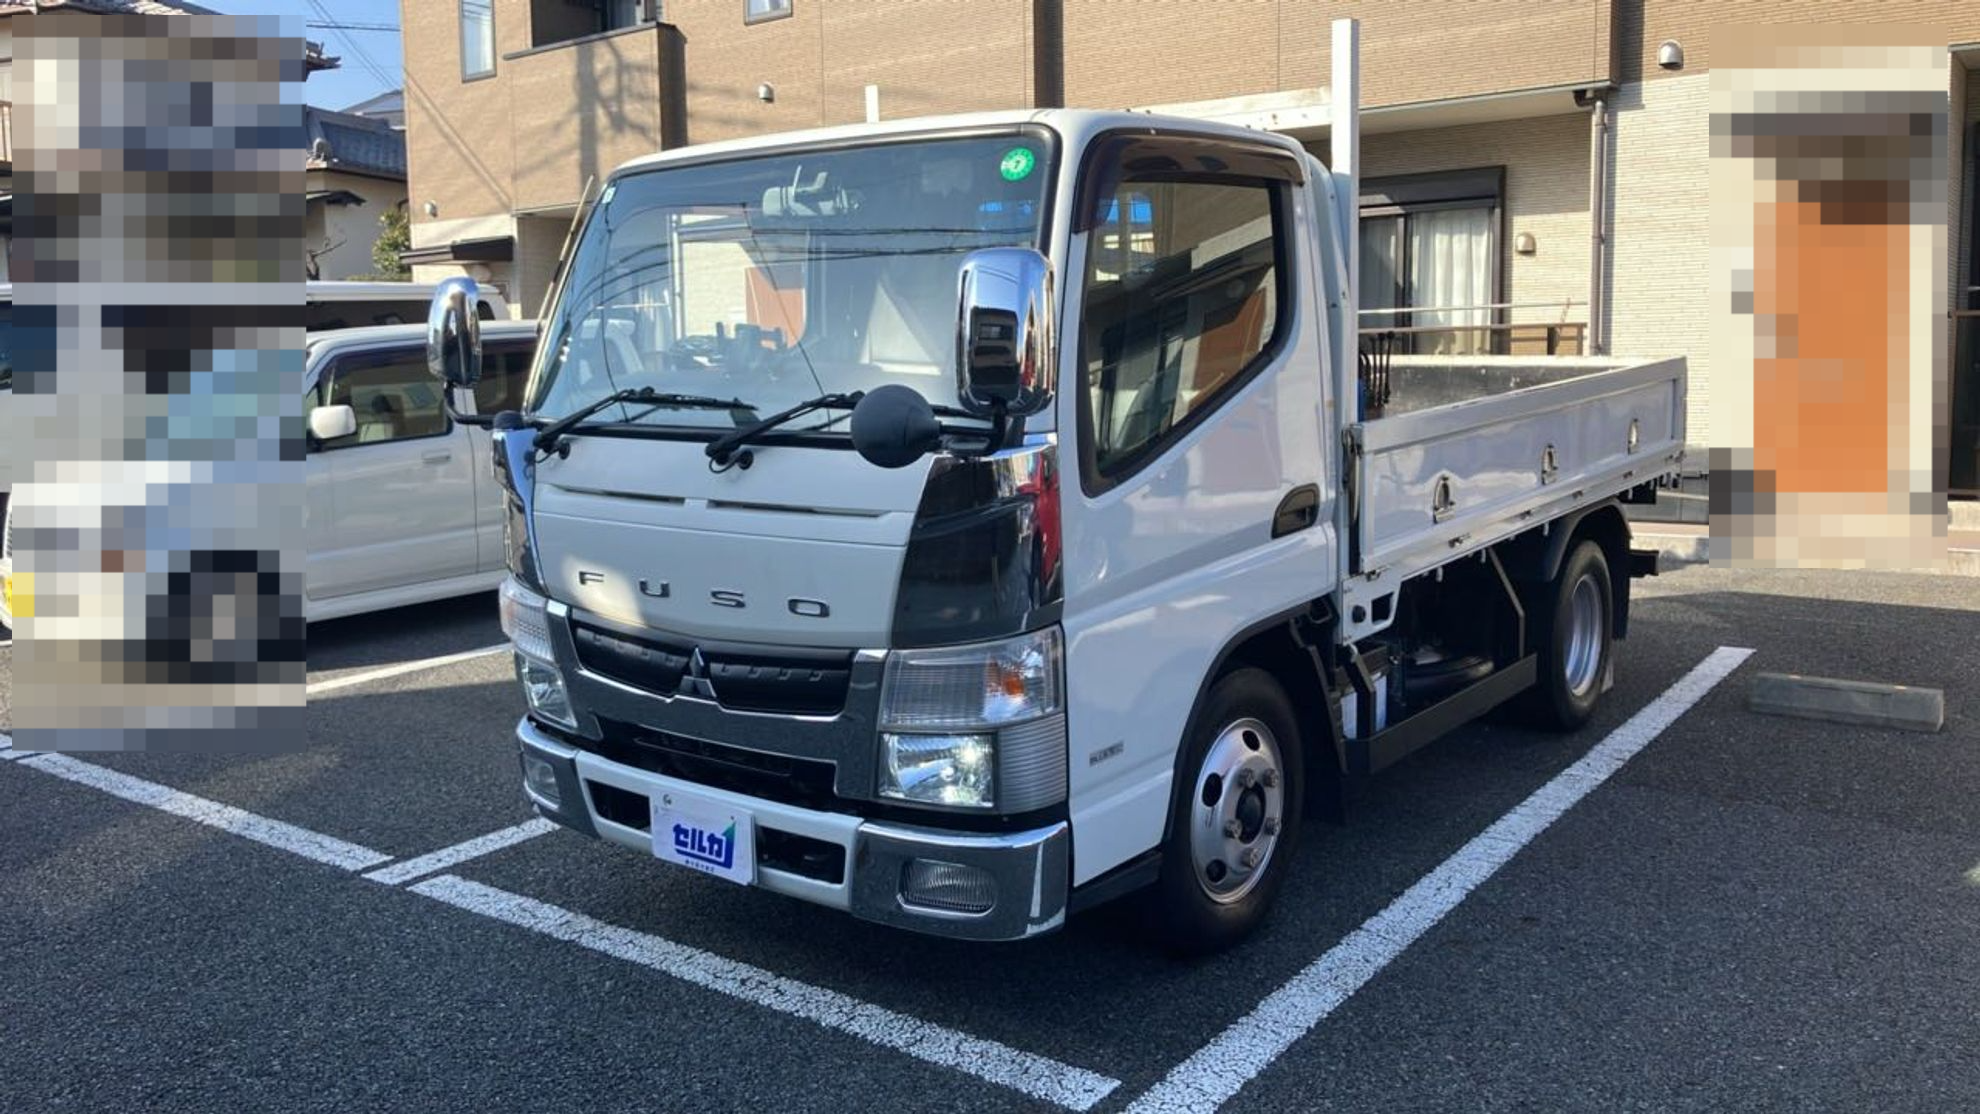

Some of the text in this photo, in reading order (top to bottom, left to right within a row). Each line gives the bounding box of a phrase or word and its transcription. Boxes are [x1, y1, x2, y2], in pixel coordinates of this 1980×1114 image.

[578, 571, 831, 618] FUSO
[672, 823, 724, 859] セルカ
